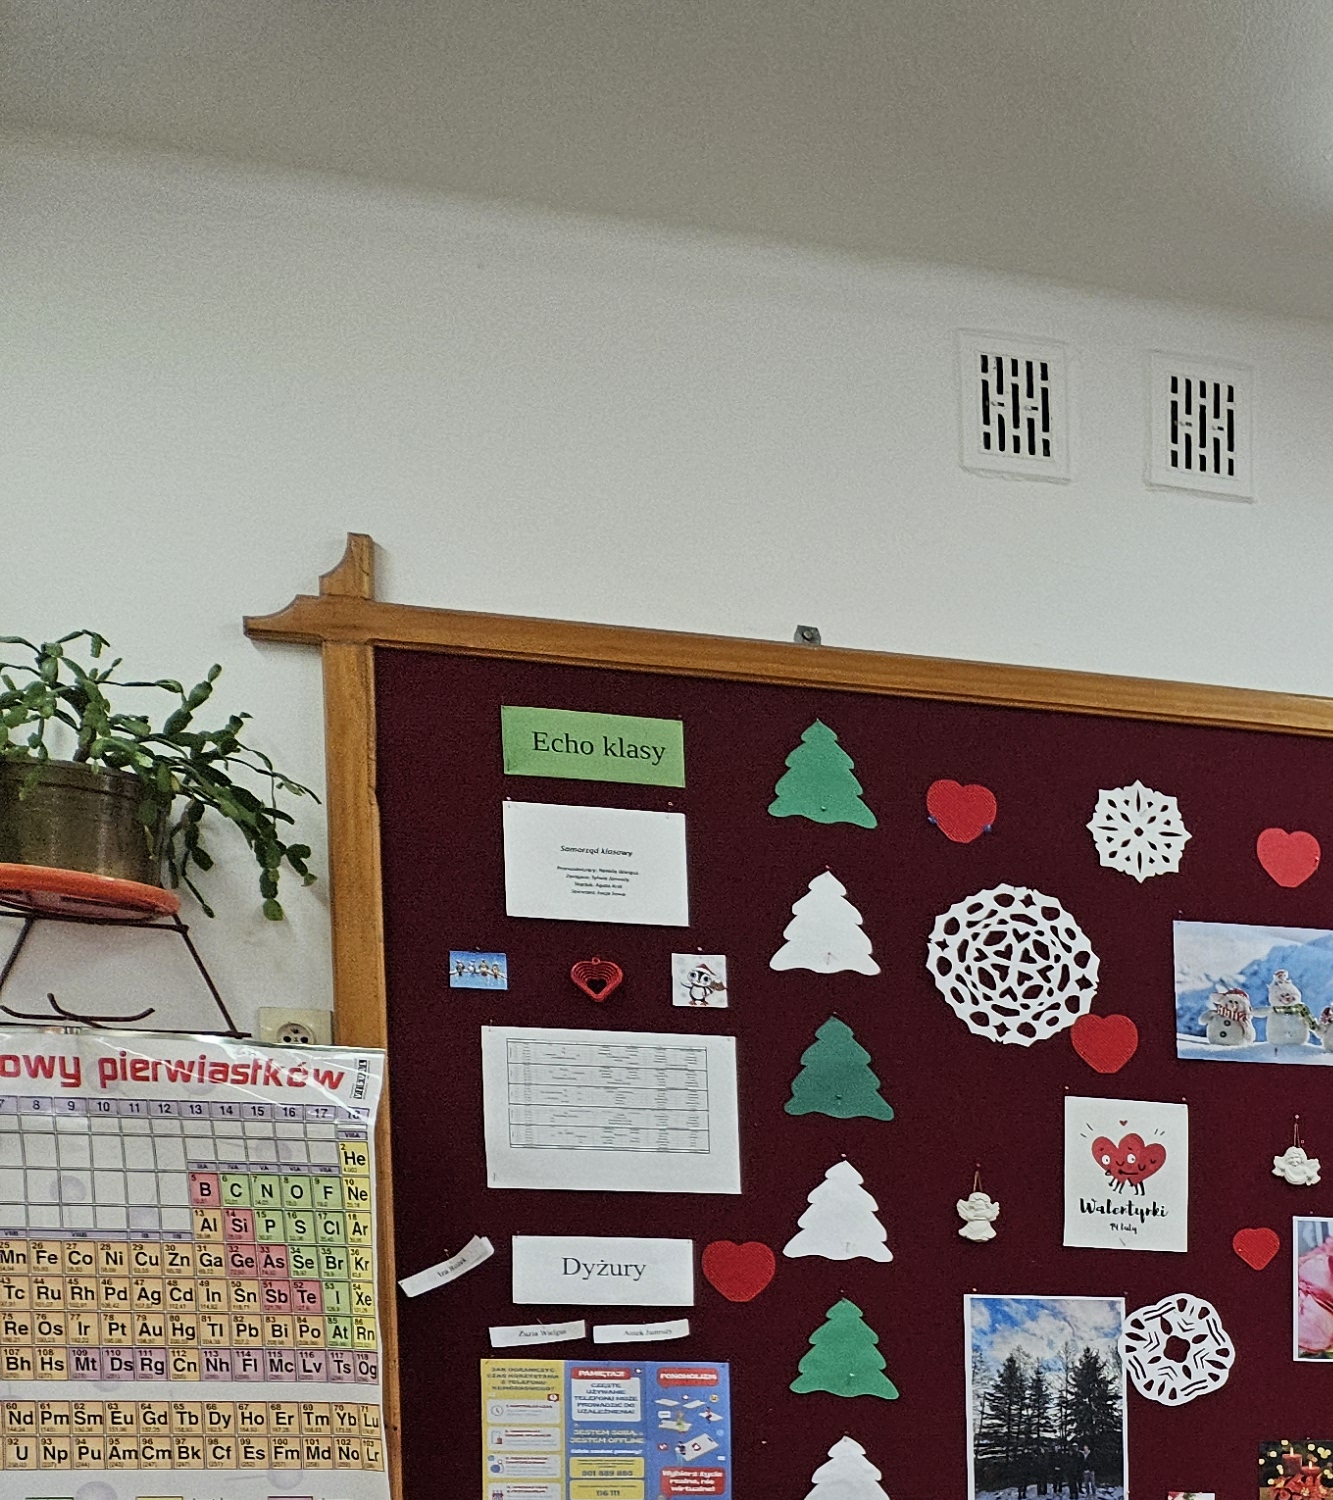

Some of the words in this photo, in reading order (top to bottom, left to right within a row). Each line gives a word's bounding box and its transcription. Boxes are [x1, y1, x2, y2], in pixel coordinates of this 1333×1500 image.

[532, 730, 594, 755] Echo
[603, 735, 666, 766] klasy
[100, 1050, 345, 1090] pierwiastków
[31, 1100, 41, 1111] 8
[66, 1100, 76, 1111] 9
[97, 1101, 111, 1112] 10
[128, 1103, 141, 1113] 11
[159, 1103, 172, 1115] 12
[189, 1104, 203, 1115] 13
[220, 1105, 234, 1116] 14
[251, 1106, 265, 1117] 15
[282, 1106, 296, 1117] 16
[344, 1150, 366, 1166] He
[200, 1183, 212, 1197] B
[230, 1183, 243, 1198] C
[261, 1184, 274, 1198] N
[291, 1185, 304, 1199] O
[324, 1186, 334, 1199] F
[347, 1186, 369, 1201] Ne
[36, 1250, 59, 1264] Fe
[68, 1251, 93, 1265] Co
[105, 1251, 124, 1266] Ni
[135, 1251, 159, 1266] Cu
[168, 1252, 190, 1267] Zn
[199, 1253, 223, 1268] Ga
[231, 1253, 255, 1268] Ge
[264, 1254, 285, 1269] As
[292, 1255, 315, 1270] Se
[326, 1256, 344, 1270] Br
[355, 1257, 370, 1271] Kr
[561, 1257, 647, 1281] Dyżury
